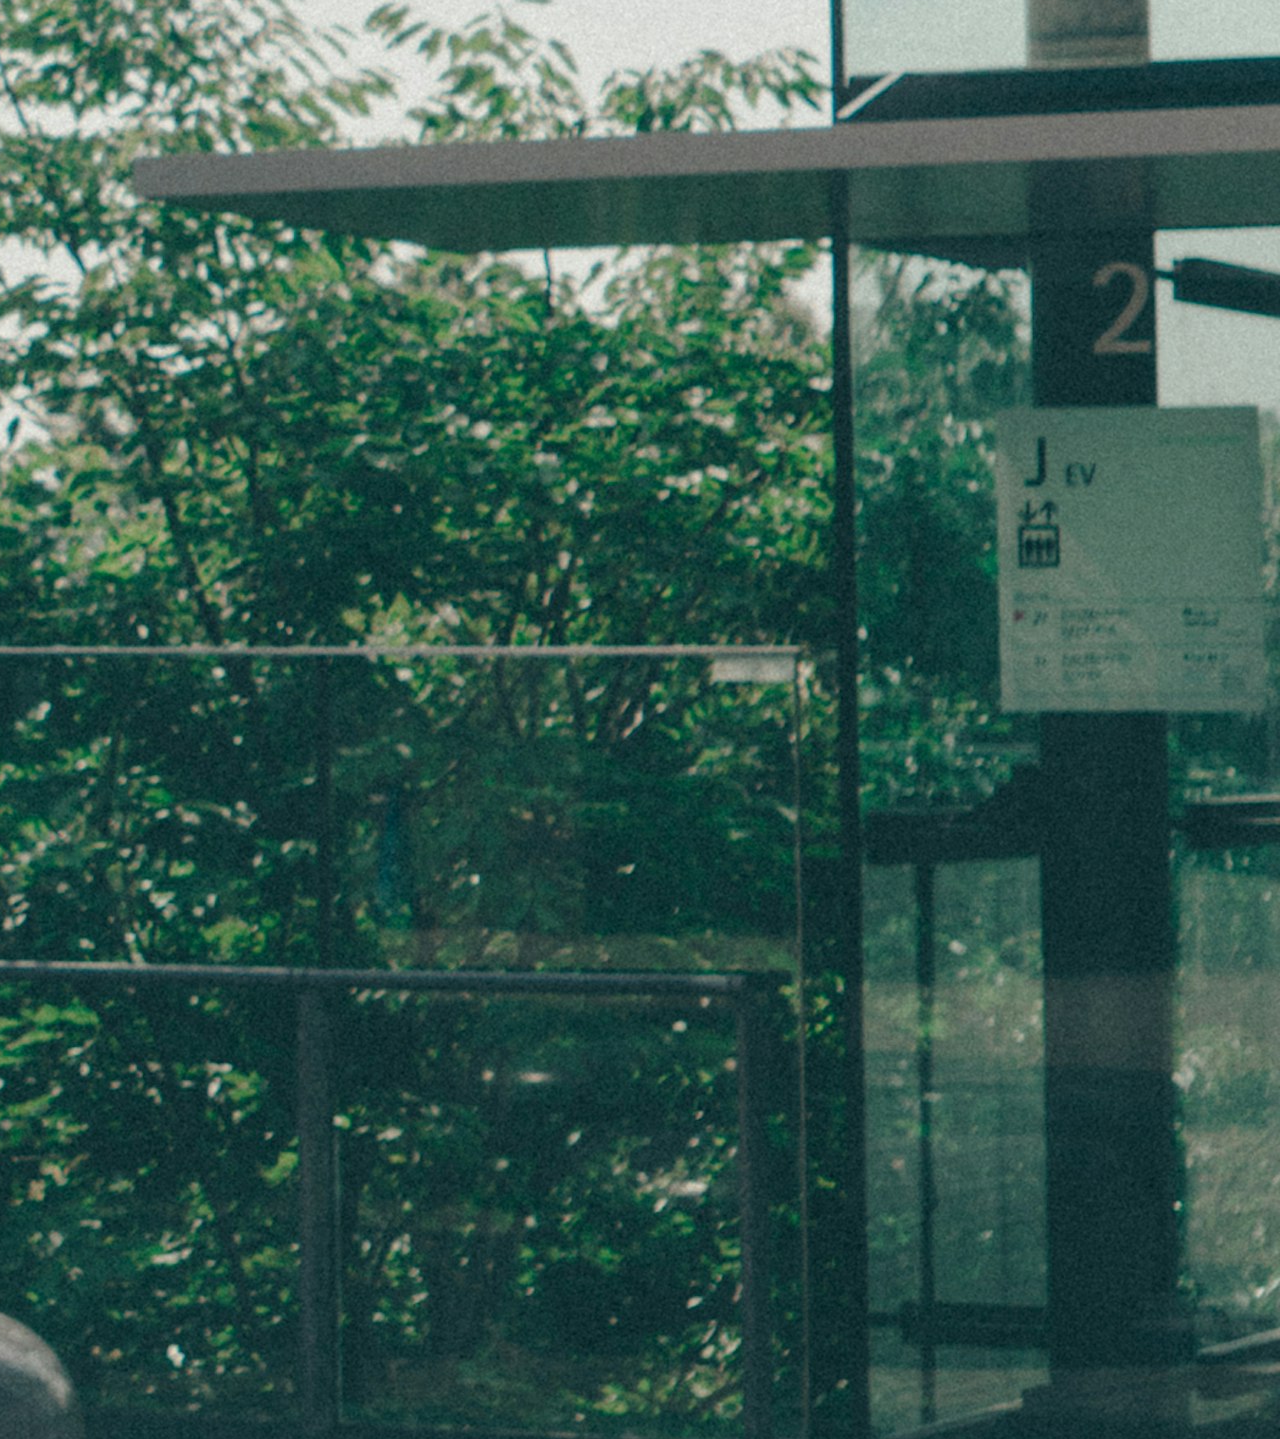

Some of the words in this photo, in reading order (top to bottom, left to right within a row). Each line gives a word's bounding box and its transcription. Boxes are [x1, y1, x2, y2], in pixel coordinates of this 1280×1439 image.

[1092, 261, 1151, 354] 2
[1024, 436, 1047, 488] J
[1064, 462, 1097, 488] EV
